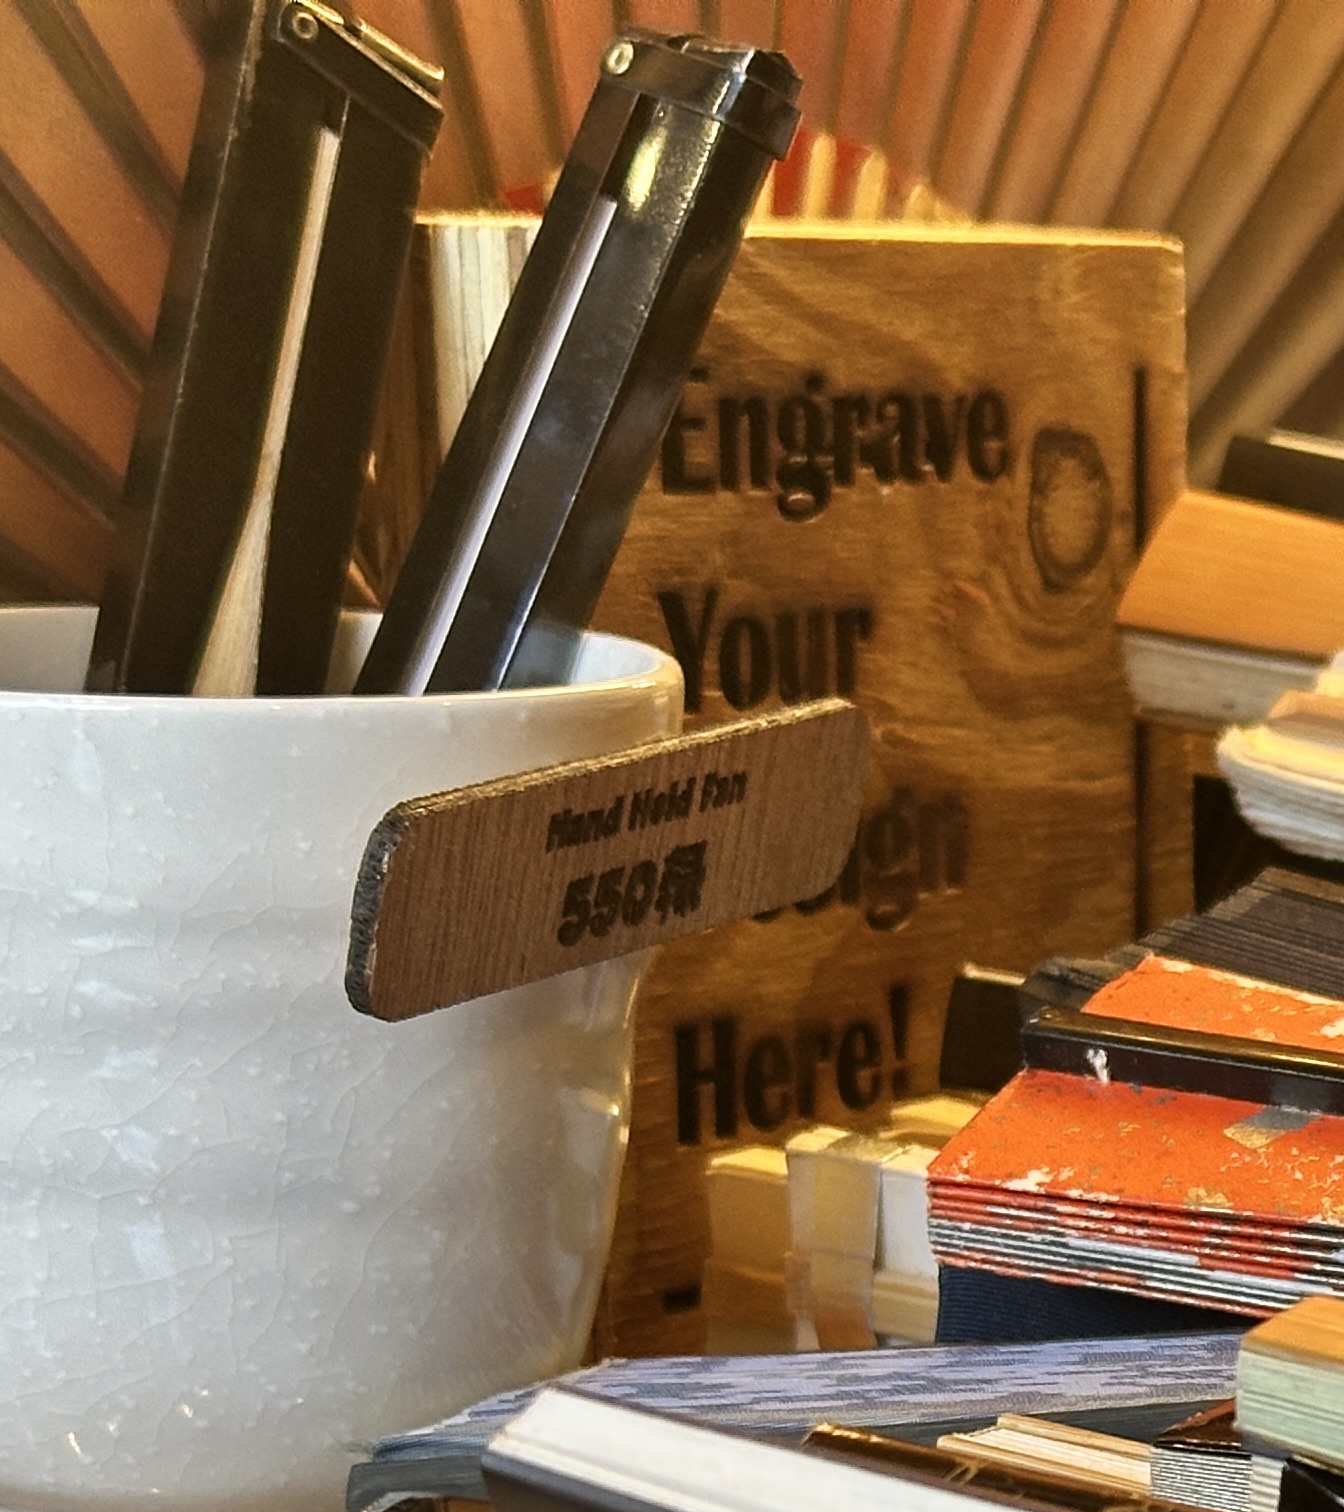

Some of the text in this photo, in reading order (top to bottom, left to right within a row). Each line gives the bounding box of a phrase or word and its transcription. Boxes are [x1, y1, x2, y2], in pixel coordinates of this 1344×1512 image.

[661, 367, 1016, 522] Engrave
[658, 587, 873, 712] Your
[699, 770, 748, 812] Fan
[673, 984, 912, 1146] Here!
